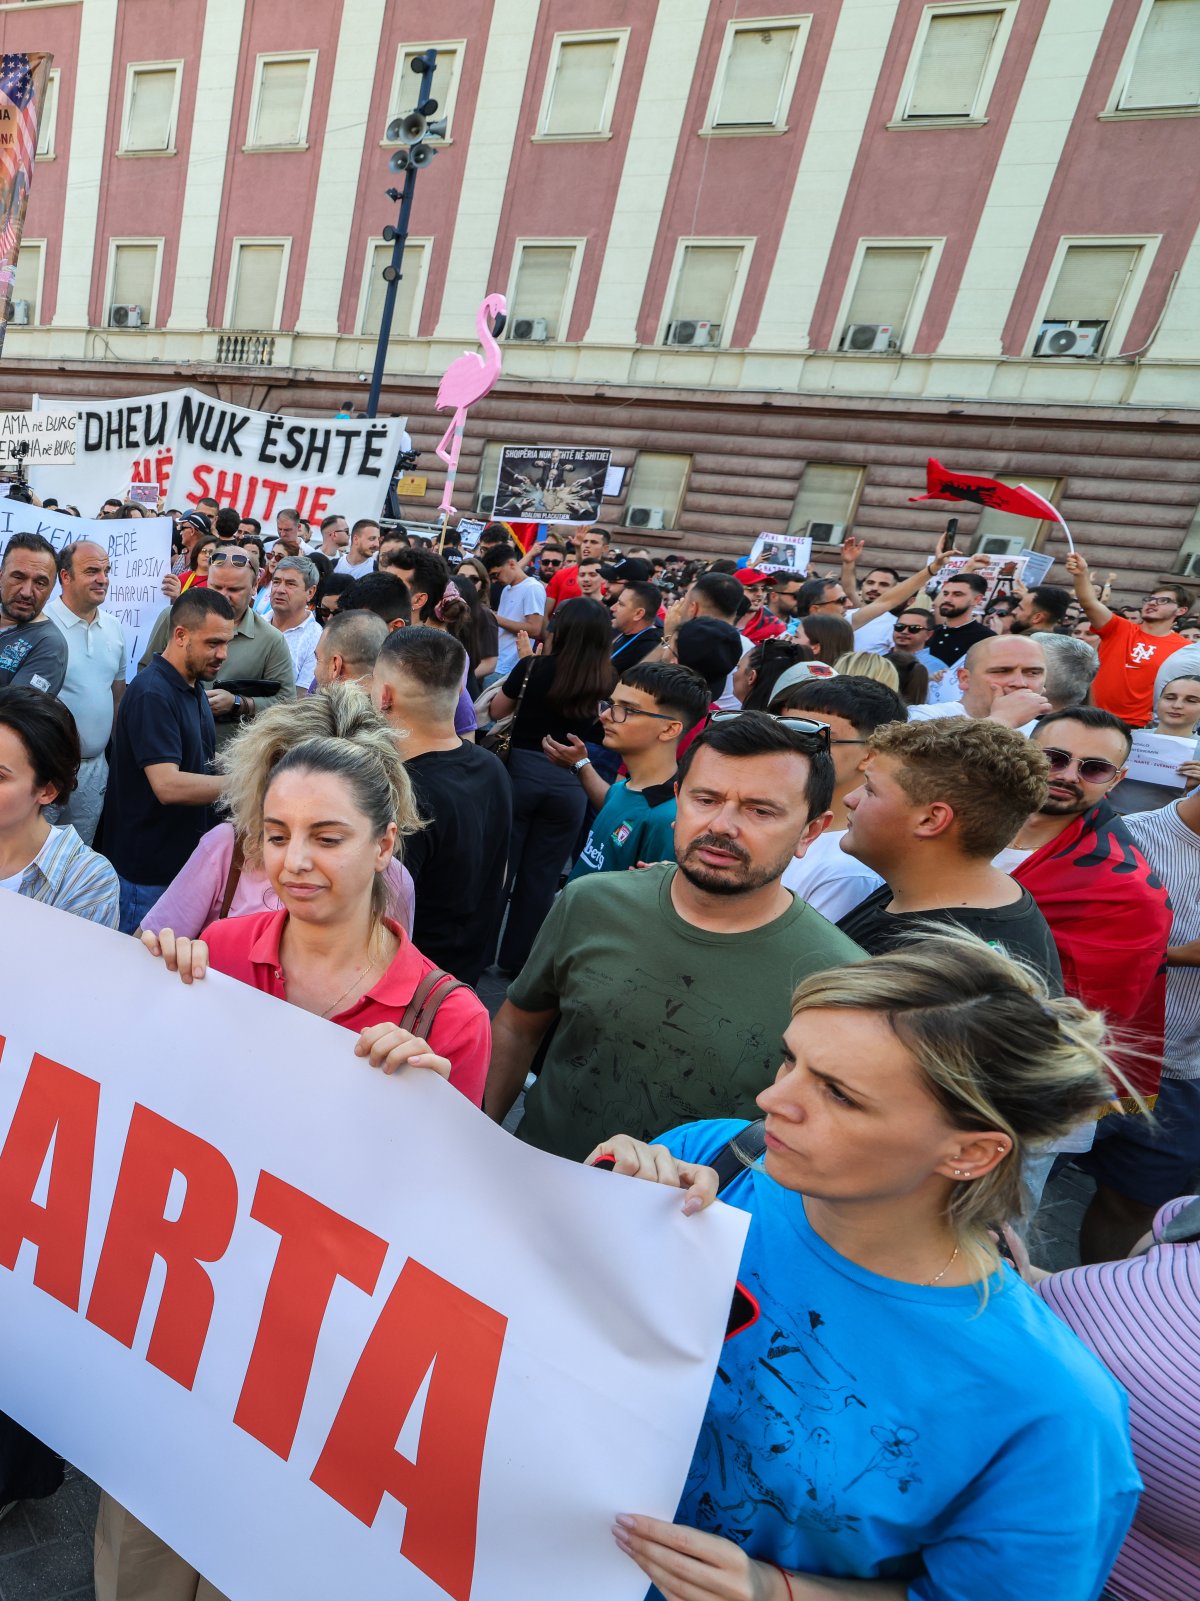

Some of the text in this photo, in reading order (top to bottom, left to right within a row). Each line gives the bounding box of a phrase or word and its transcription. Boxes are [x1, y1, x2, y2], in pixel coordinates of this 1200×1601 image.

[32, 421, 44, 432] në
[45, 415, 77, 432] BURG
[176, 396, 249, 458] NUK
[258, 414, 389, 478] ËSHTË
[42, 443, 53, 456] në
[54, 440, 77, 456] BURG
[505, 448, 538, 459] SHQIPËRIA
